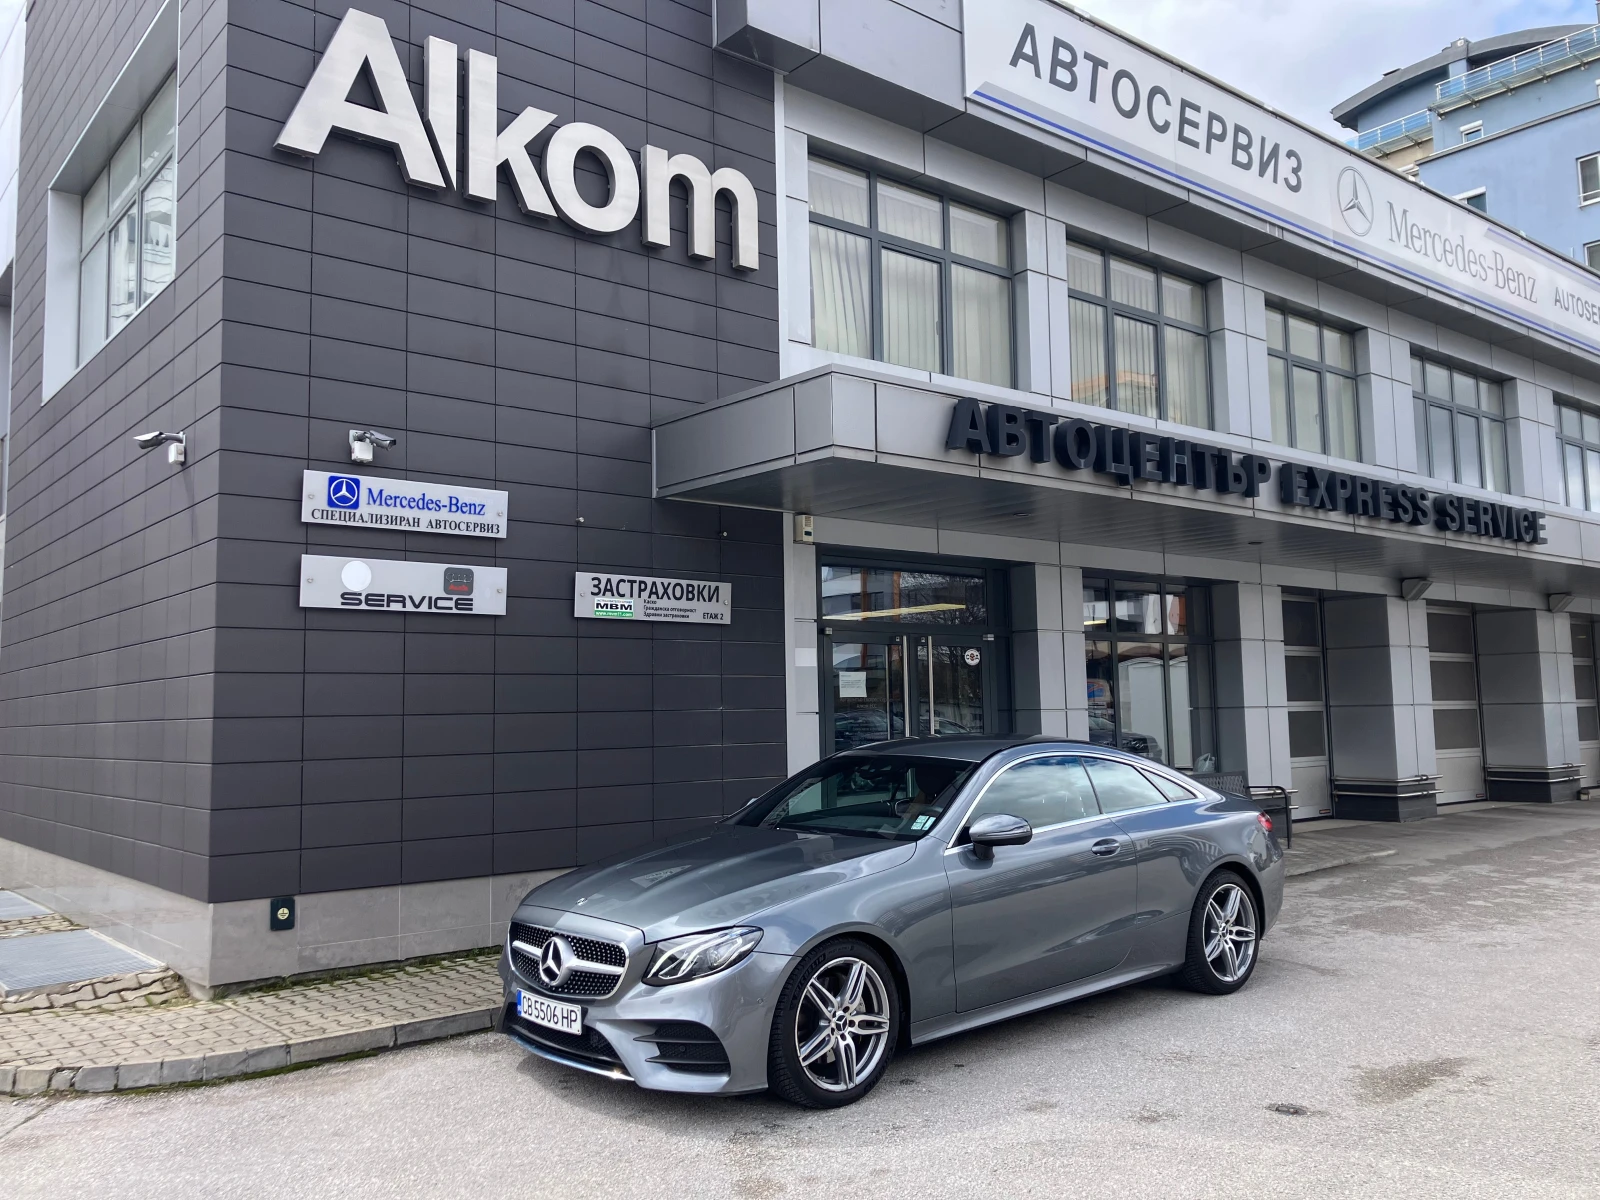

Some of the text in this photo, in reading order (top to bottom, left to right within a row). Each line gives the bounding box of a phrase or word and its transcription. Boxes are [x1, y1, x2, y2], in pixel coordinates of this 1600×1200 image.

[1008, 22, 1303, 194] АВТОСЕРВИЗ
[274, 7, 759, 273] Alkom
[1387, 200, 1538, 304] Mercedes-Benz
[945, 397, 1548, 545] АВТОЦЕНТЪР EXPRESS SERVICE
[366, 487, 486, 516] Mercedes-Benz
[311, 508, 500, 534] СПЕЦИАЛИЗИРАН АВТОСЕРВИЗ
[340, 591, 474, 612] SERVICE
[590, 576, 720, 603] ЗАСТРАХОВКИ
[702, 612, 724, 621] ЕТАЖ 2
[522, 995, 578, 1029] CB 5506 HP
